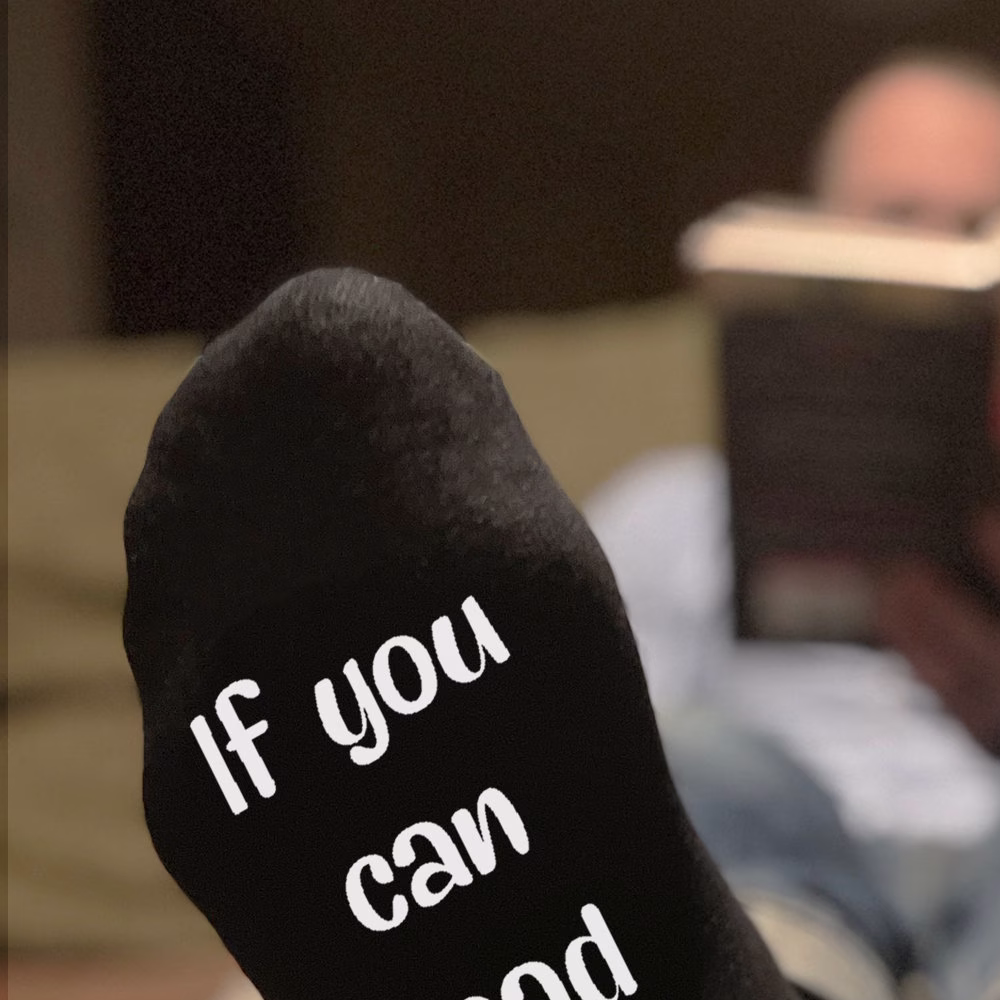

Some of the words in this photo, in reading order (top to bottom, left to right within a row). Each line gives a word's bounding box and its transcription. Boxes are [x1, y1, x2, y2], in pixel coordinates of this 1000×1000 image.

[189, 678, 277, 816] If
[314, 595, 511, 766] you
[345, 787, 530, 932] can
